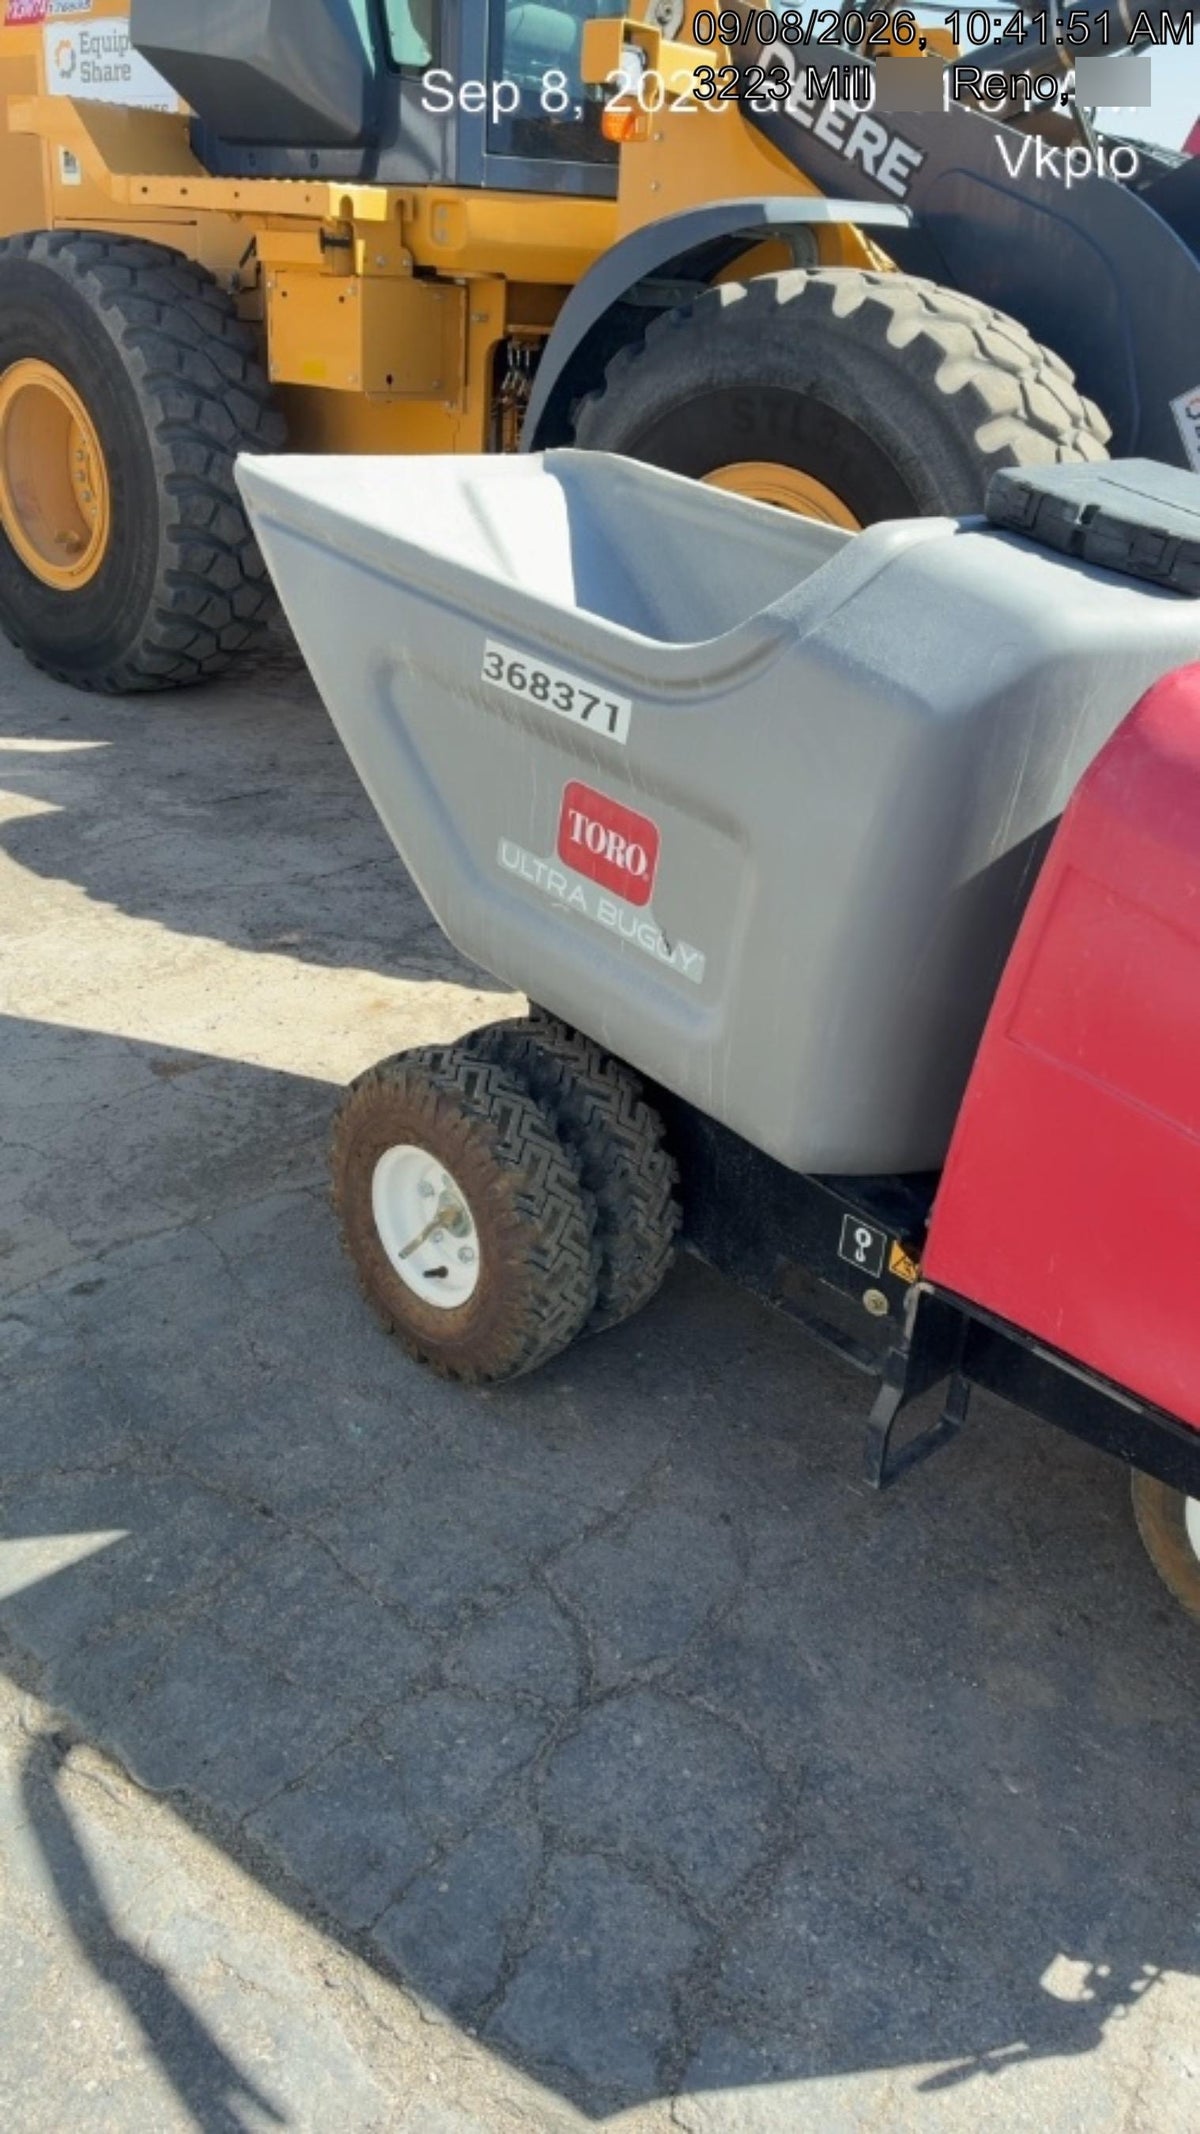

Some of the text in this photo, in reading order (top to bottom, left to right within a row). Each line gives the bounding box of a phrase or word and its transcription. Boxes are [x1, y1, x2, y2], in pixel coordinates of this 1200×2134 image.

[80, 61, 132, 83] Share
[747, 38, 925, 199] DEERE
[483, 651, 622, 733] 368371
[501, 841, 588, 911] ULTRA
[568, 808, 650, 877] TORO
